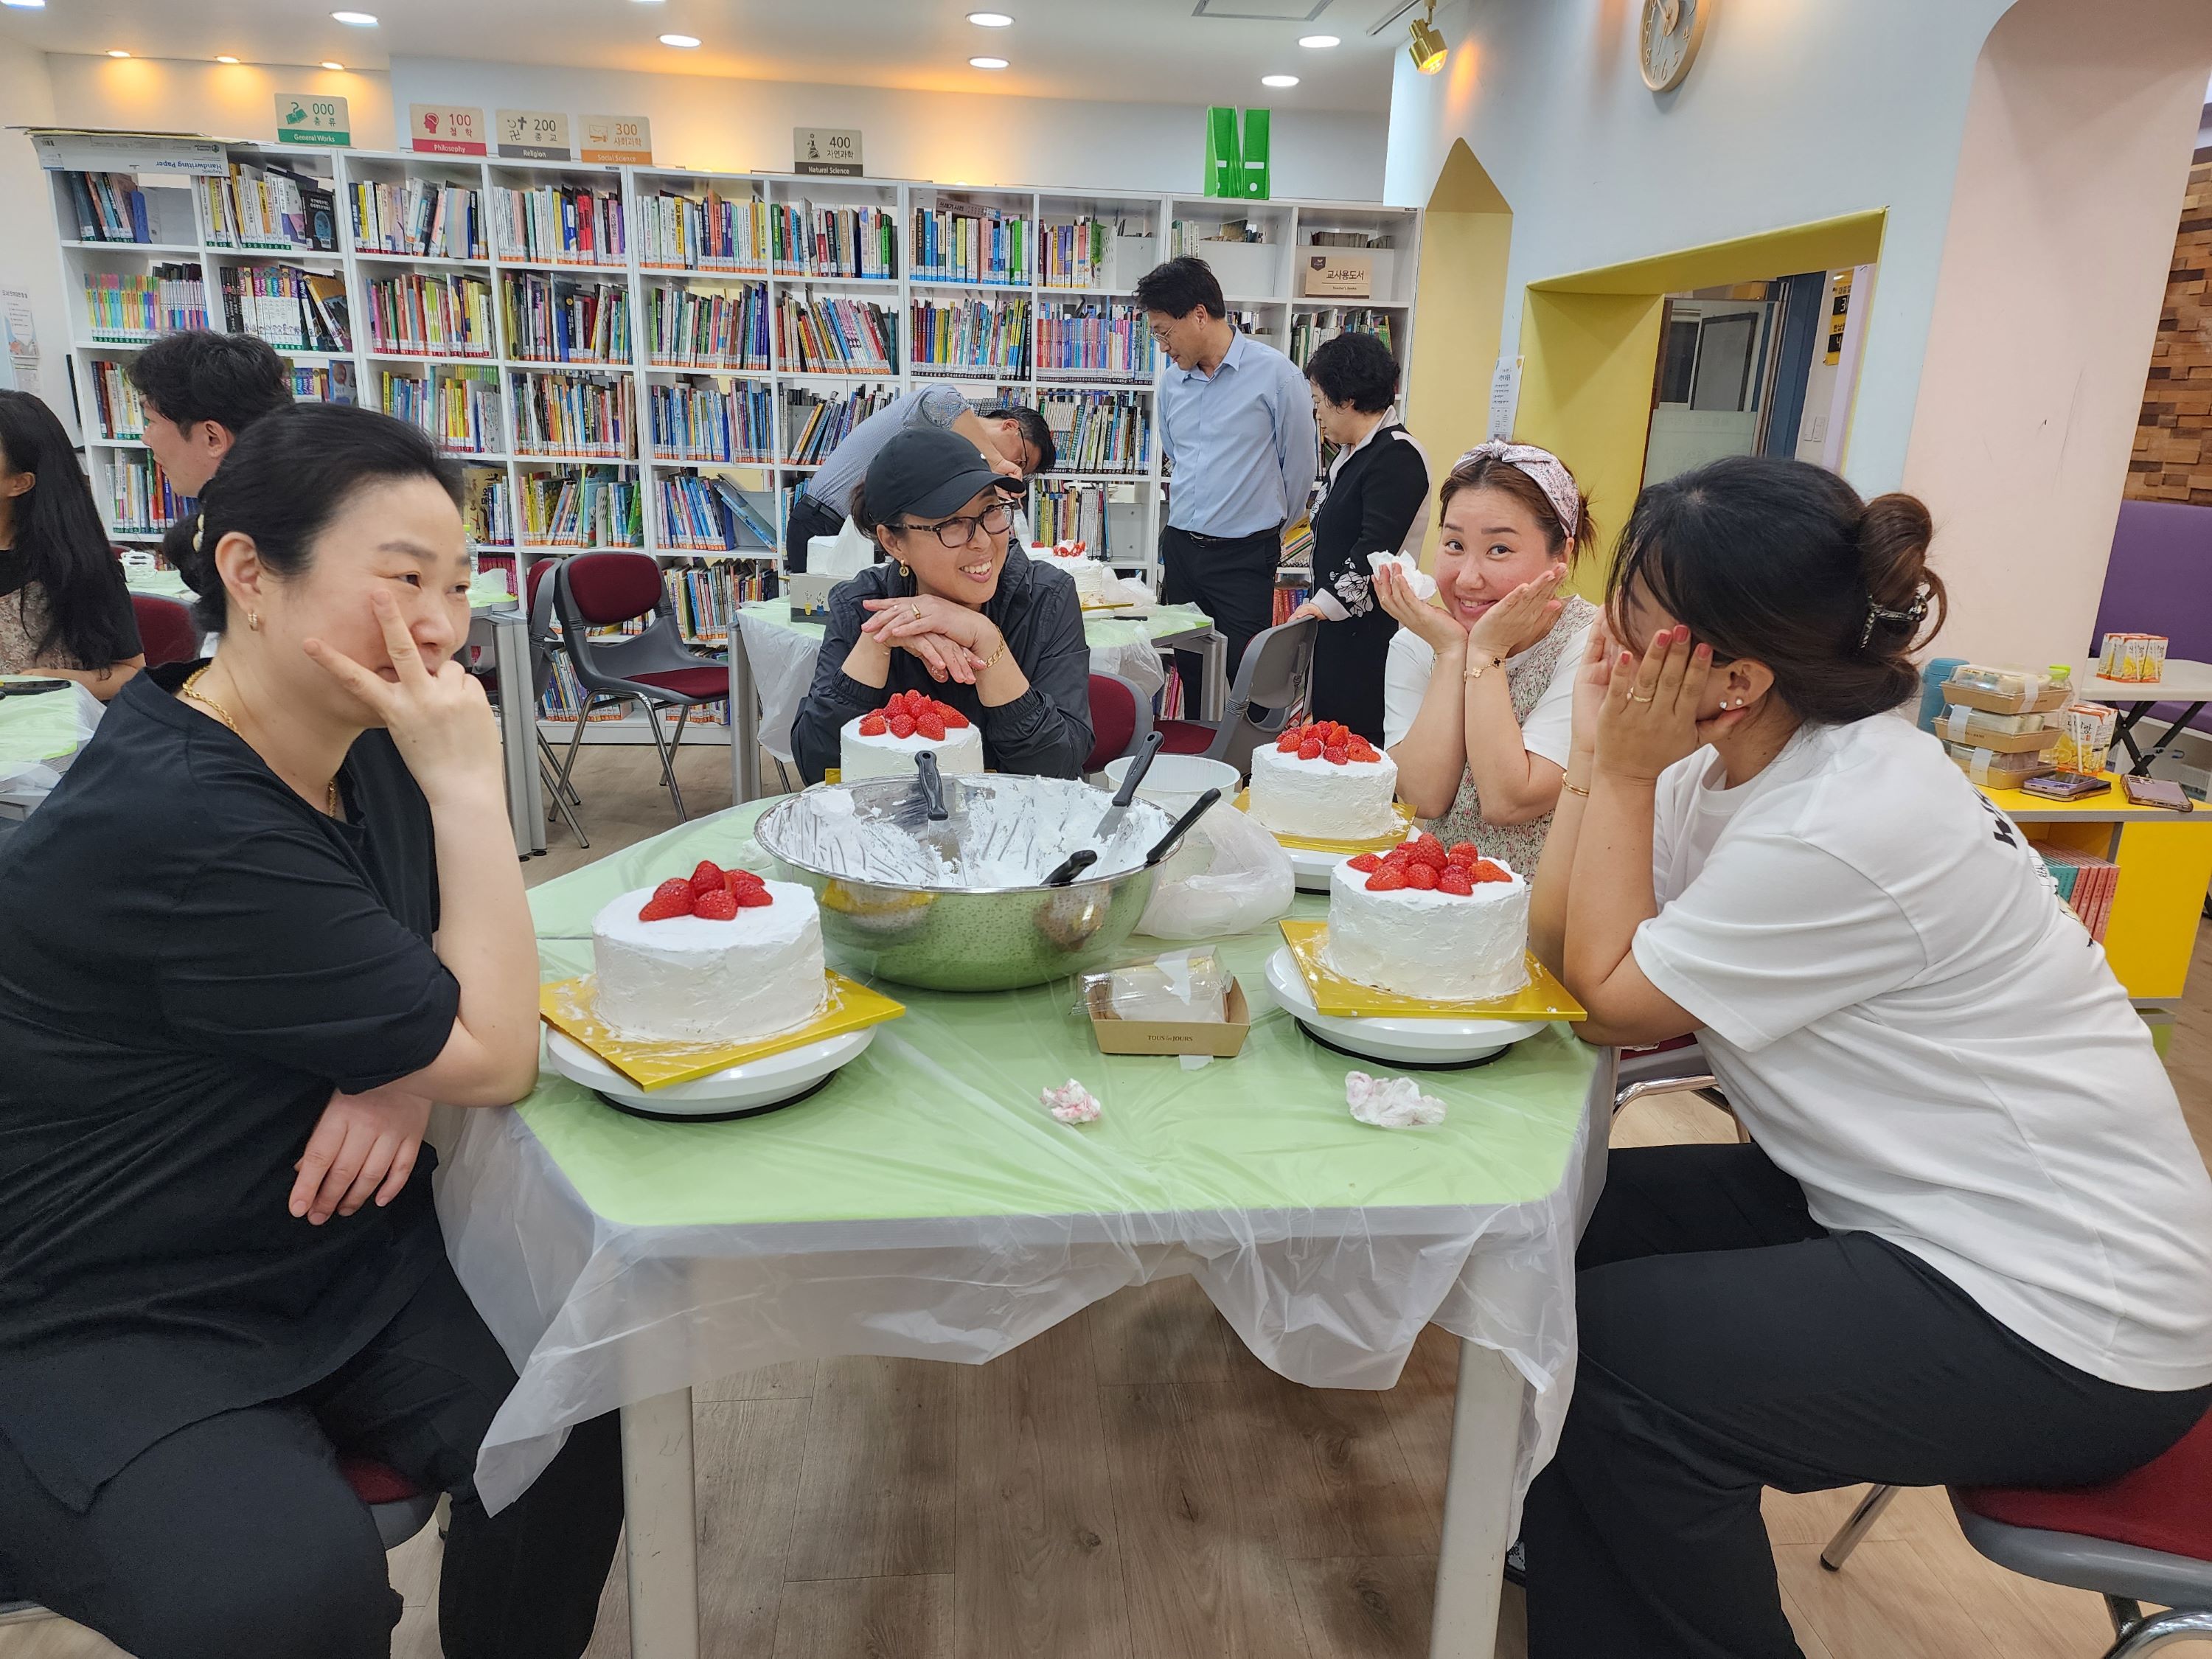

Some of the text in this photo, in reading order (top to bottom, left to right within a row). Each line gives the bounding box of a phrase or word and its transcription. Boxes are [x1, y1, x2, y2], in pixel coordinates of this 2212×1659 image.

[1645, 20, 1652, 44] 9
[1683, 26, 1689, 42] 4
[1646, 48, 1651, 65] 8
[1673, 49, 1680, 67] 5
[1661, 58, 1667, 80] 6
[313, 103, 335, 115] 000
[449, 114, 472, 126] 100
[534, 119, 556, 131] 200
[616, 123, 637, 136] 300
[293, 133, 335, 142] General Works
[613, 137, 641, 147] 사회과학
[829, 136, 851, 148] 400
[434, 144, 465, 153] Philosophy
[523, 150, 546, 158] Religion
[827, 150, 854, 159] 자연과학
[597, 153, 636, 163] Social Science
[178, 161, 223, 170] Handwriting
[808, 166, 829, 174] Natural
[1326, 270, 1365, 280] 교사용도서
